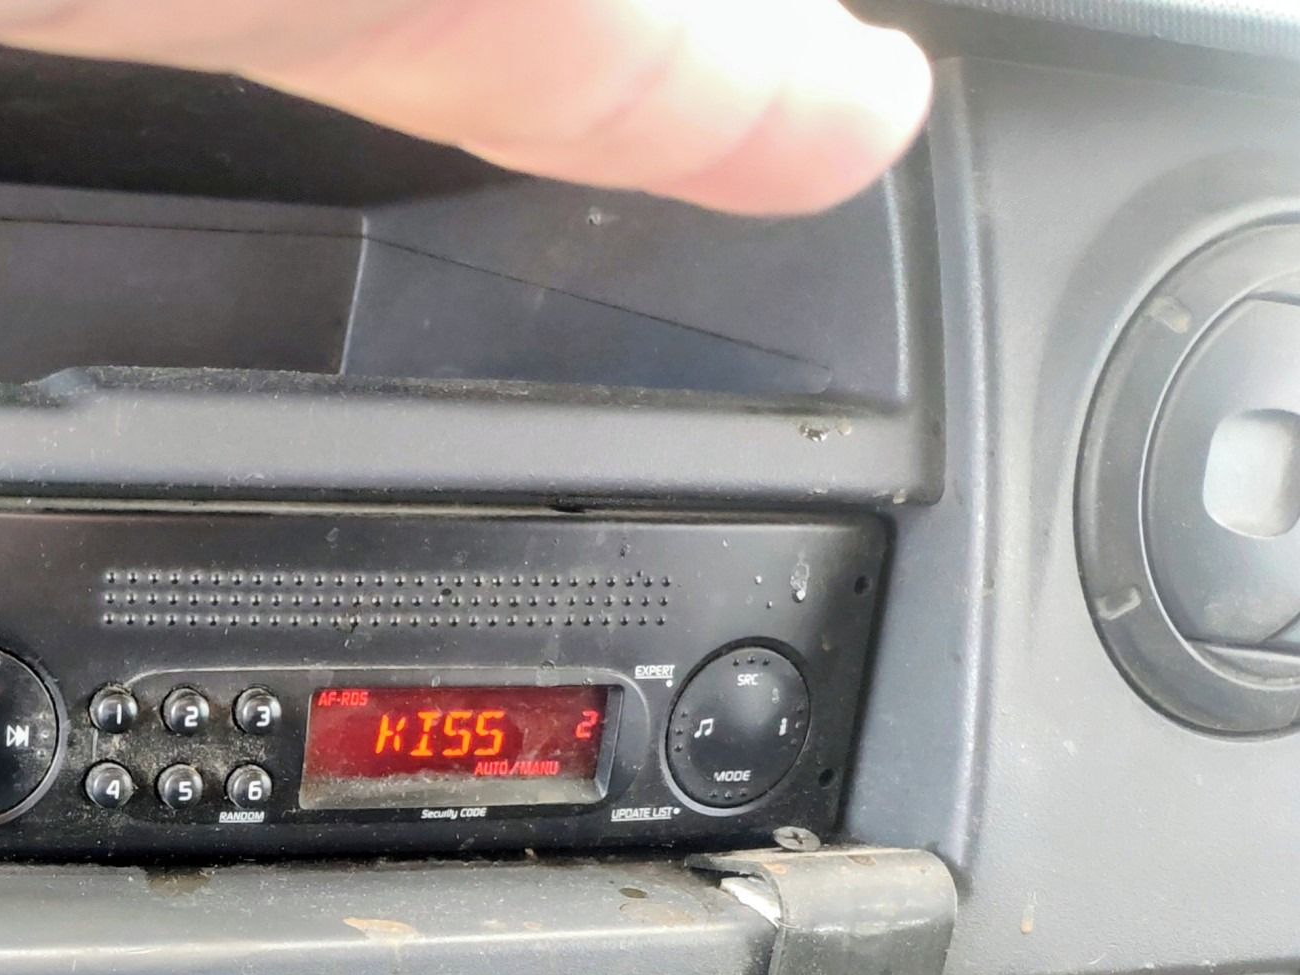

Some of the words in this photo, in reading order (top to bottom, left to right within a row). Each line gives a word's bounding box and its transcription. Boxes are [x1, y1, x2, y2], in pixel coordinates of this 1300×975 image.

[634, 664, 675, 679] EXPERT
[736, 674, 759, 686] SRC
[318, 691, 369, 706] AF-RDS
[116, 703, 123, 725] 1
[184, 706, 199, 727] 2
[256, 706, 271, 727] 3
[574, 710, 599, 739] 2
[375, 710, 506, 757] KISS
[714, 770, 752, 782] MODE
[106, 780, 120, 799] 4
[178, 781, 192, 801] 5
[248, 781, 262, 800] 6
[219, 811, 265, 823] RANDOM
[421, 808, 458, 820] Security
[460, 807, 487, 818] CODE
[611, 808, 652, 821] UPDATE
[653, 807, 672, 819] LIST
